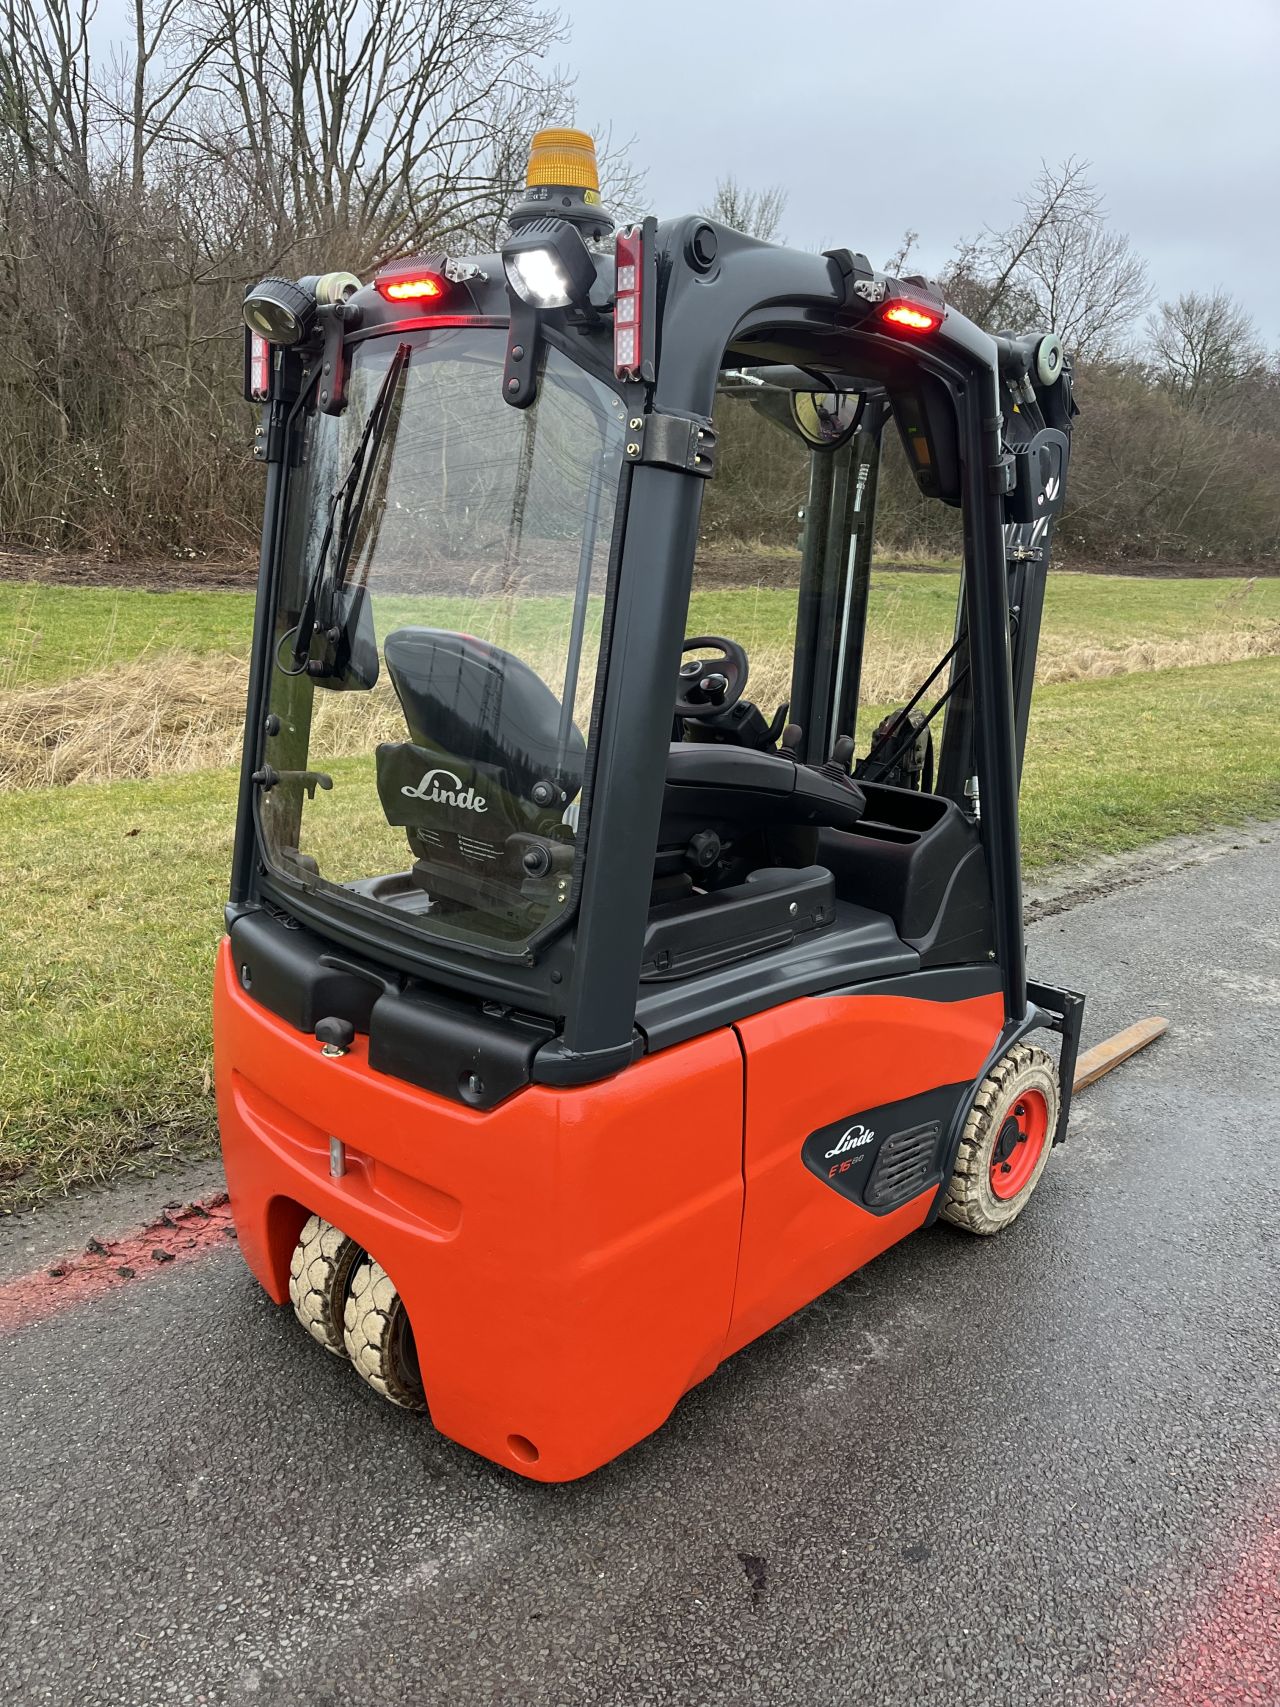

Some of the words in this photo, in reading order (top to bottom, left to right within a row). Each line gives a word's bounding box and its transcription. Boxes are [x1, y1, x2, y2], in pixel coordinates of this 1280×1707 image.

[401, 769, 488, 813] Linde
[824, 1125, 875, 1159] Linde
[829, 1164, 839, 1178] E
